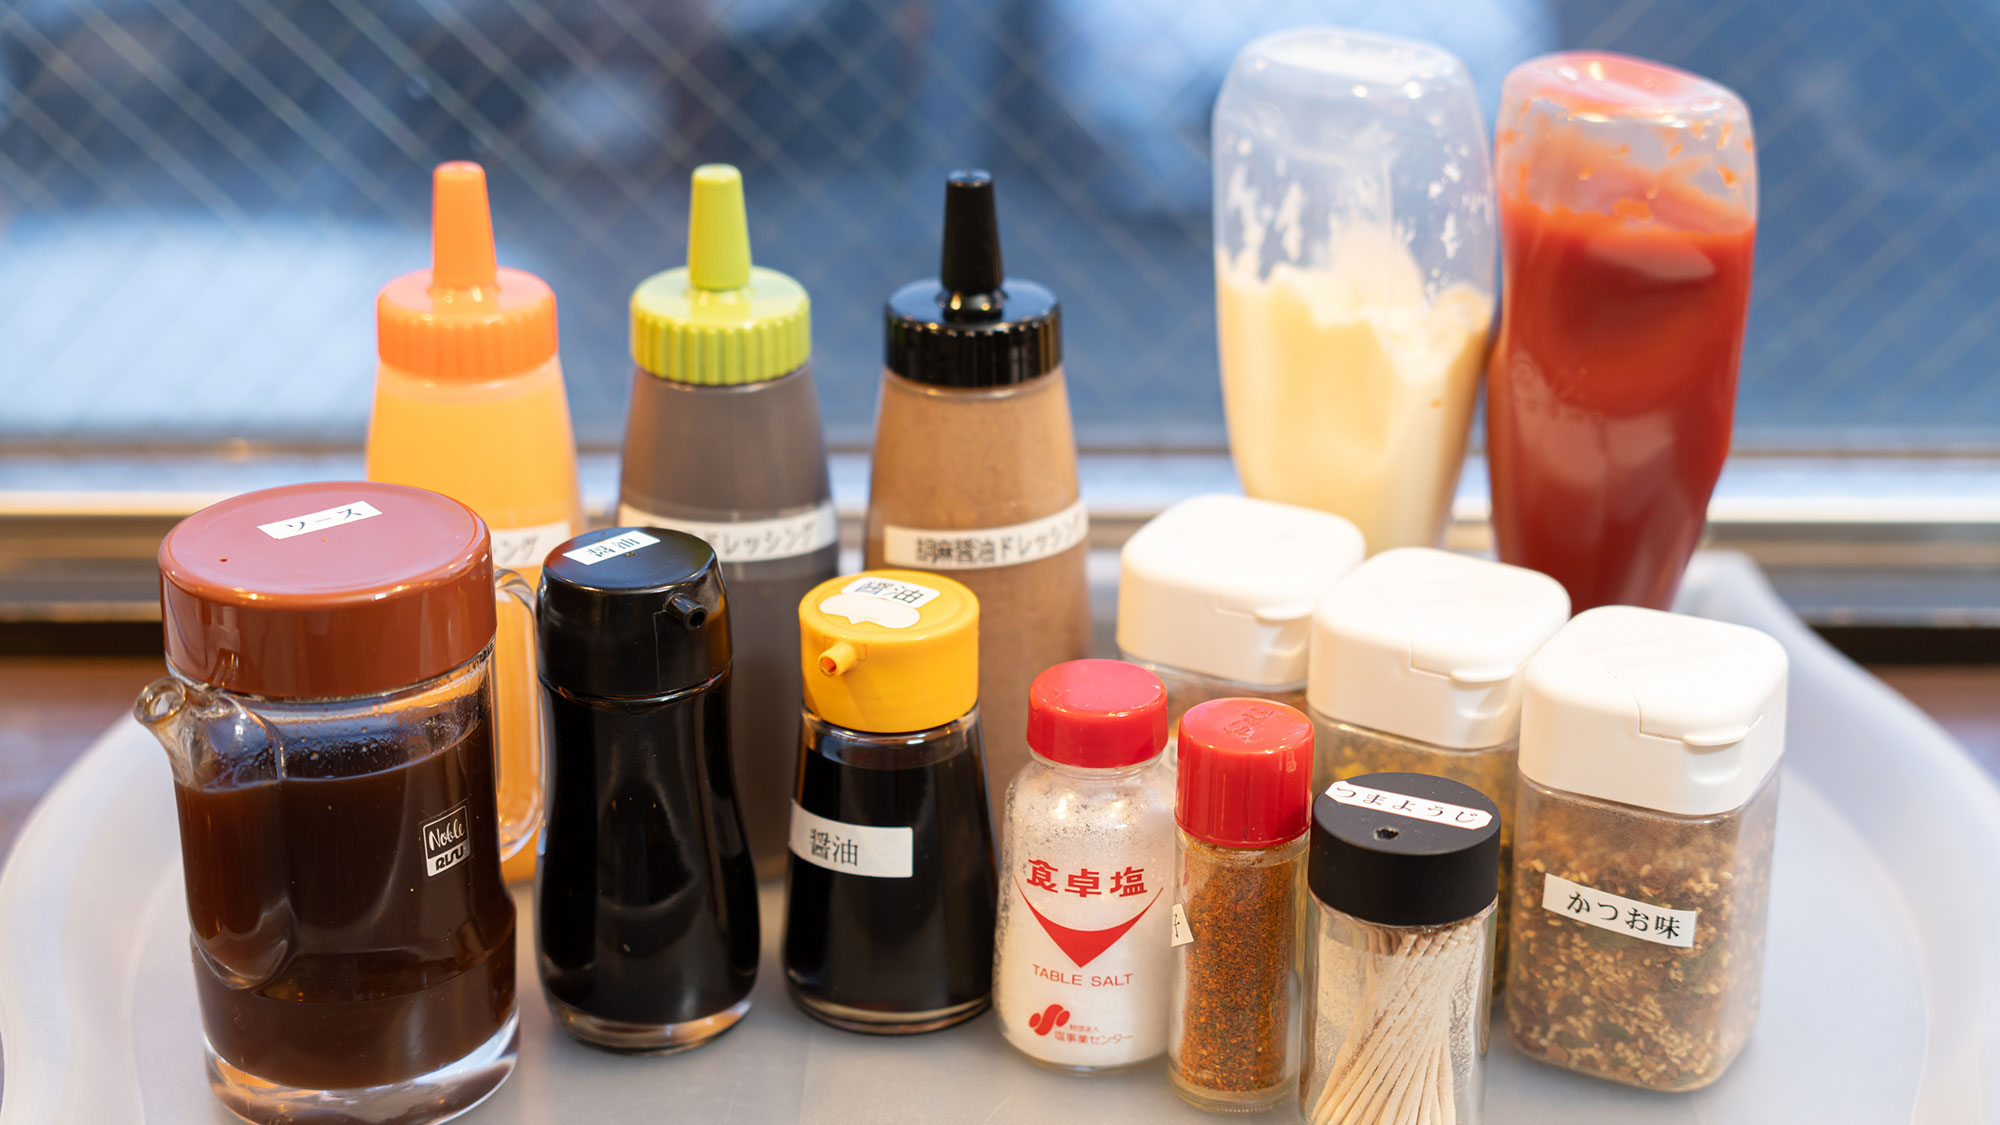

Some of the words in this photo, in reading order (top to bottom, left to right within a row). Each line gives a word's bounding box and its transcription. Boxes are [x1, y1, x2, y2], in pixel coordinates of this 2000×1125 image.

[286, 508, 363, 532] ソース
[1336, 787, 1478, 823] つまようじ
[428, 818, 465, 851] Noble
[810, 828, 858, 866] 醤油
[1026, 858, 1148, 898] 食卓塩
[1567, 891, 1681, 940] かつお味
[1032, 963, 1083, 987] TABLE
[1091, 973, 1133, 987] SALT
